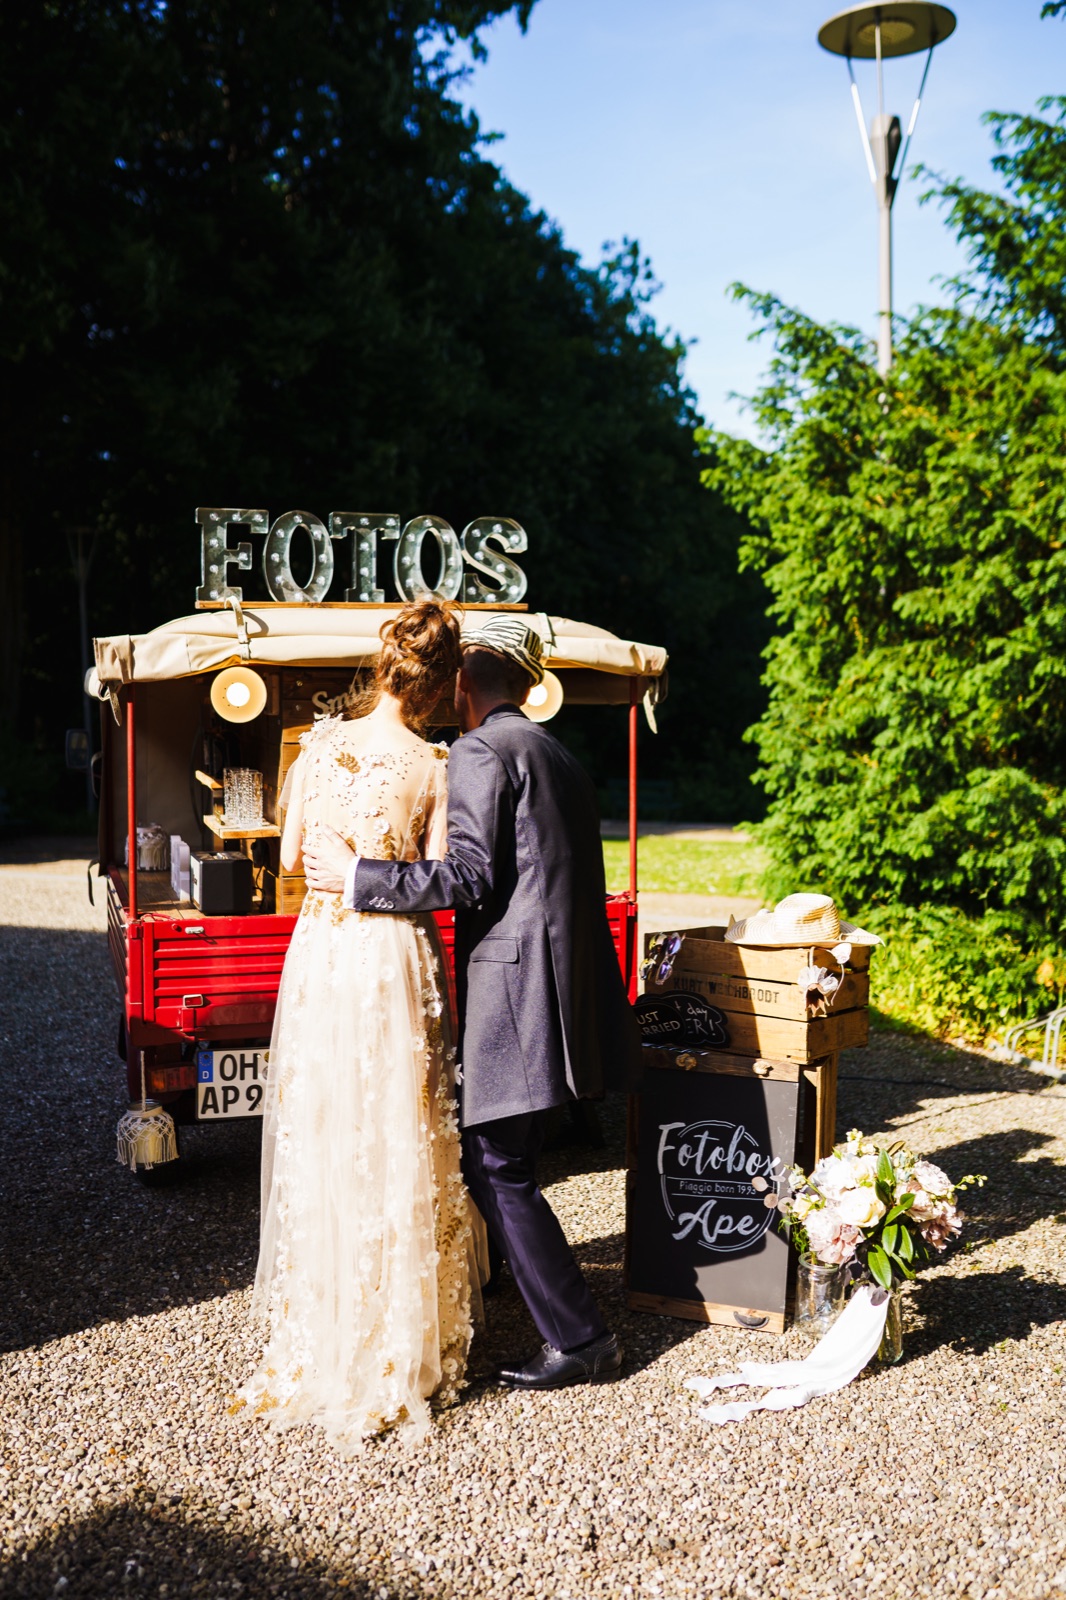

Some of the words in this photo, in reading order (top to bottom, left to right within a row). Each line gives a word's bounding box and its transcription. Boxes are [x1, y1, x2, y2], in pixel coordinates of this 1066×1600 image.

[195, 507, 528, 604] FOTOS
[673, 976, 703, 992] KURT
[636, 1011, 659, 1026] UST
[687, 1003, 708, 1021] day
[641, 1020, 681, 1036] RRIED
[202, 1070, 209, 1079] D
[219, 1053, 258, 1081] OH
[200, 1085, 240, 1115] AP
[657, 1122, 783, 1177] Fotobox
[680, 1181, 713, 1195] Piaggio
[714, 1183, 735, 1194] born
[671, 1199, 760, 1243] Ape
